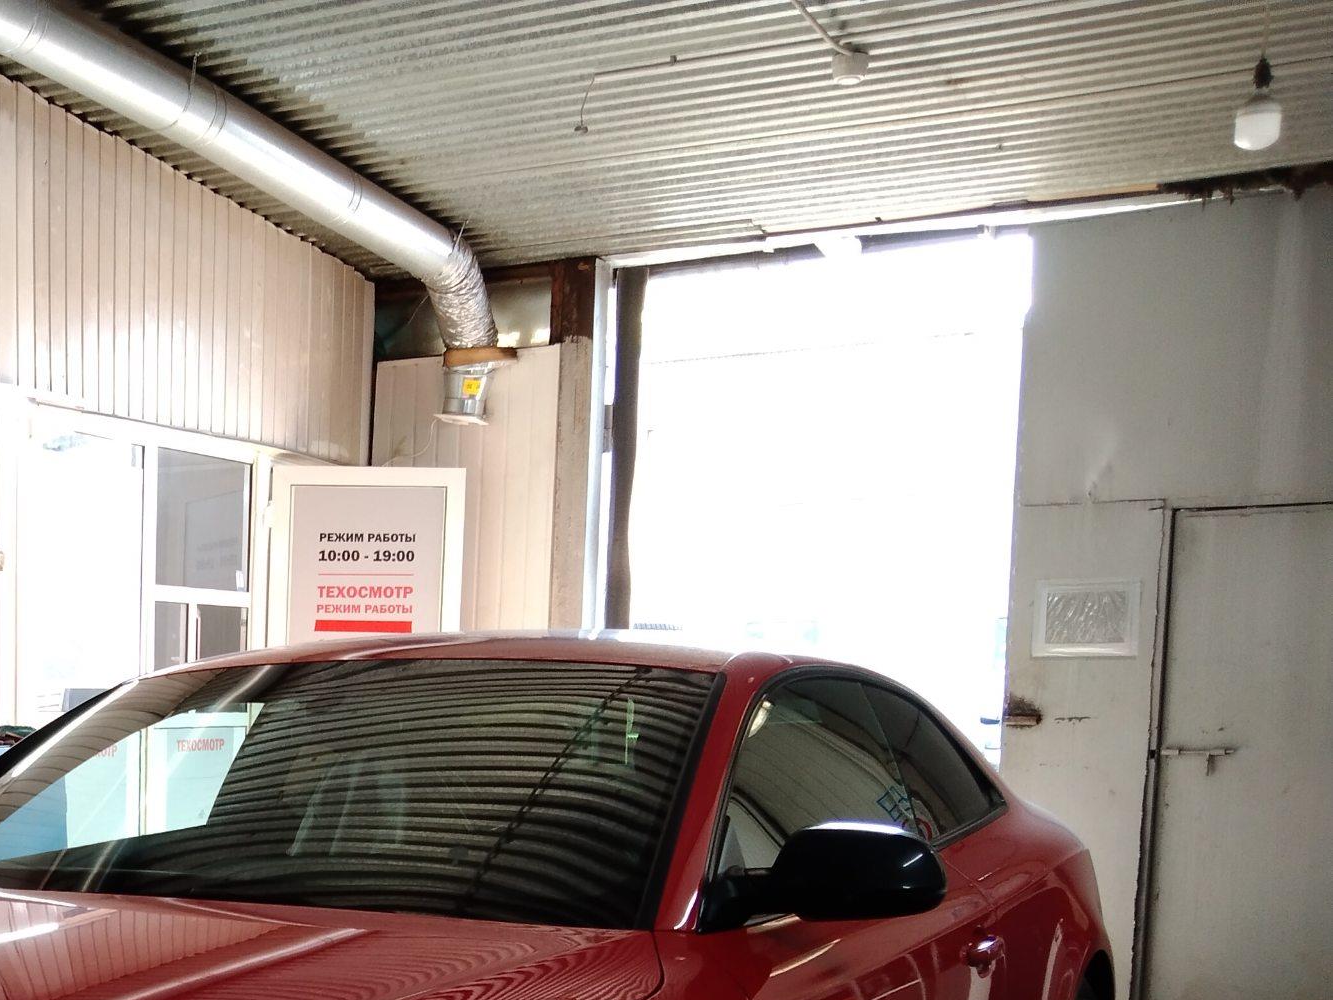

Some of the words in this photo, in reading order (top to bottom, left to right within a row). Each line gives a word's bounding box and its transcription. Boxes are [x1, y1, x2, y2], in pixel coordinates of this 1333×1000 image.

[319, 532, 364, 543] РЕЖИМ
[367, 533, 416, 543] РАБОТЫ
[318, 550, 360, 562] 10:00
[373, 550, 415, 562] 19:00
[317, 585, 414, 599] ТЕХОСМОТР
[316, 604, 361, 614] РЕЖИМ
[364, 604, 412, 614] РАБОТЫ
